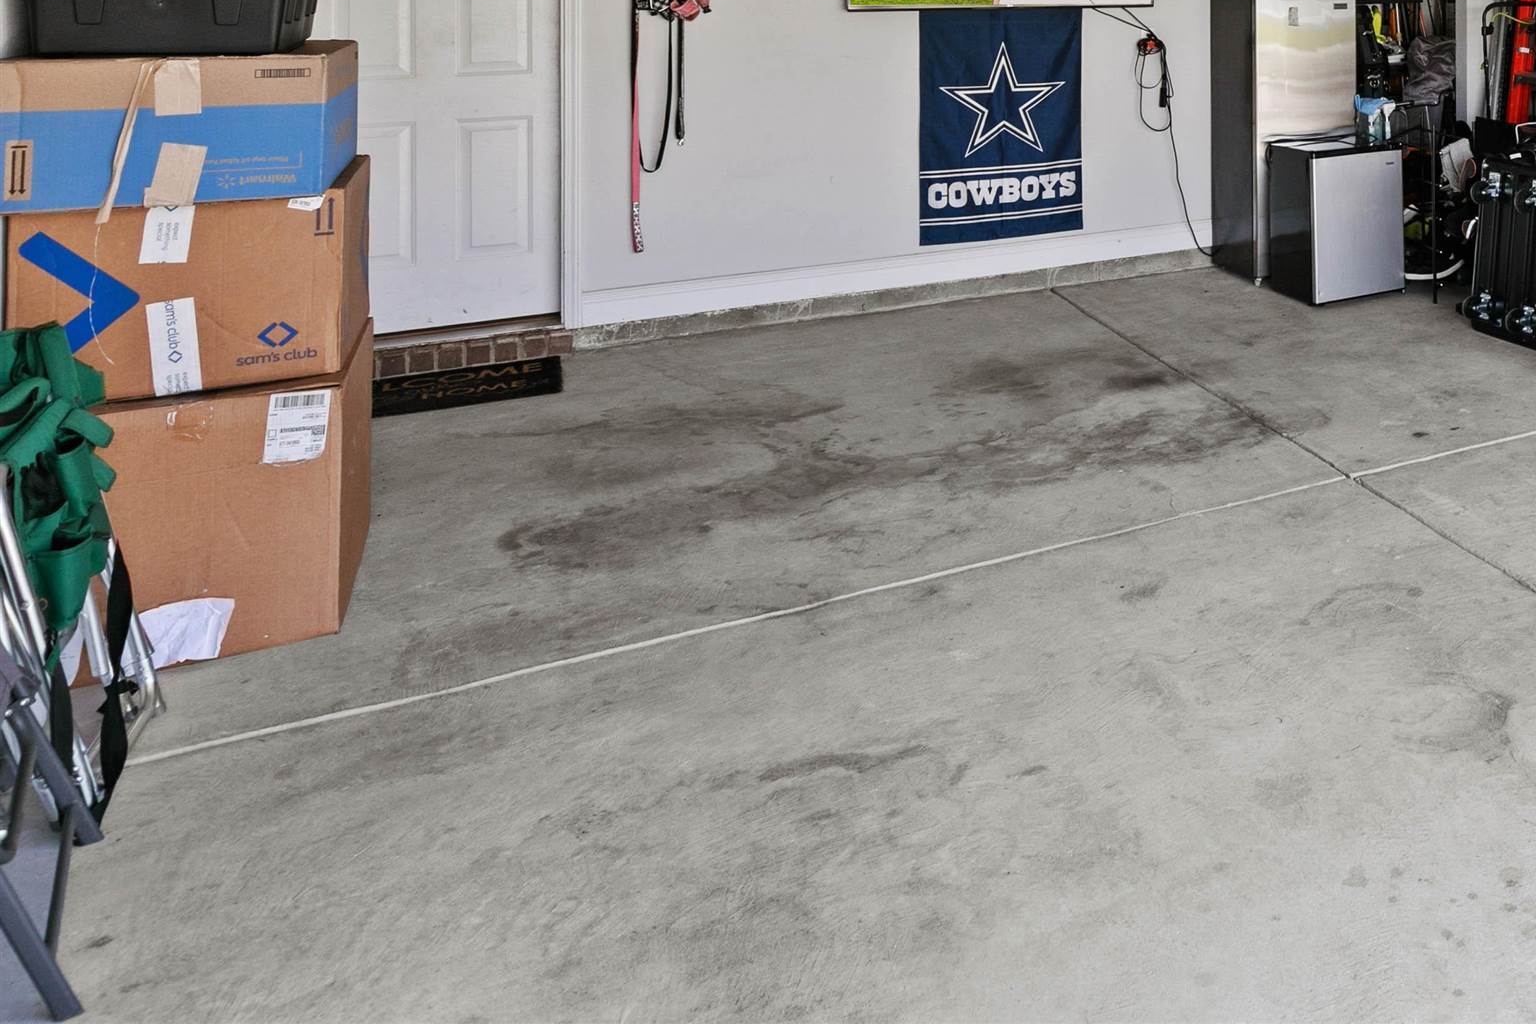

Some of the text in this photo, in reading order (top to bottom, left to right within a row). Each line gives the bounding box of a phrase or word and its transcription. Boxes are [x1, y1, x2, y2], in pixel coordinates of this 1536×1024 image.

[238, 173, 297, 186] Walmart
[927, 170, 1077, 210] COWBOYS
[167, 328, 181, 350] club
[236, 347, 318, 367] sam's club
[380, 361, 545, 394] LCOME
